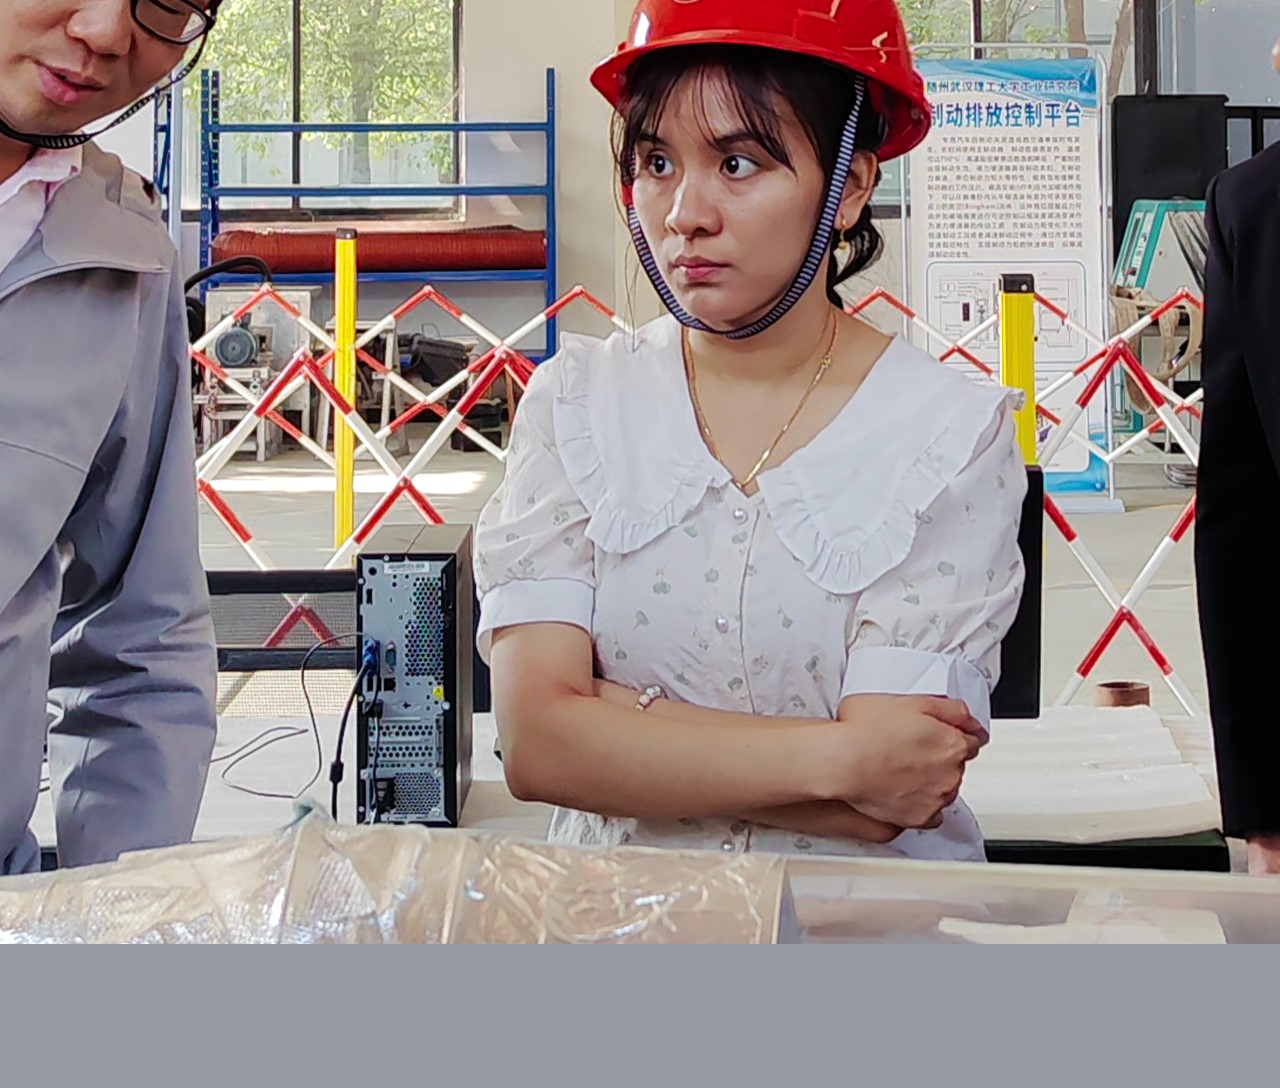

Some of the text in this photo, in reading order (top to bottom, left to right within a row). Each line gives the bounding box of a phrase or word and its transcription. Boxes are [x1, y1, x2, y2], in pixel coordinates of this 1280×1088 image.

[931, 100, 1082, 128] 制动排放控制平台
